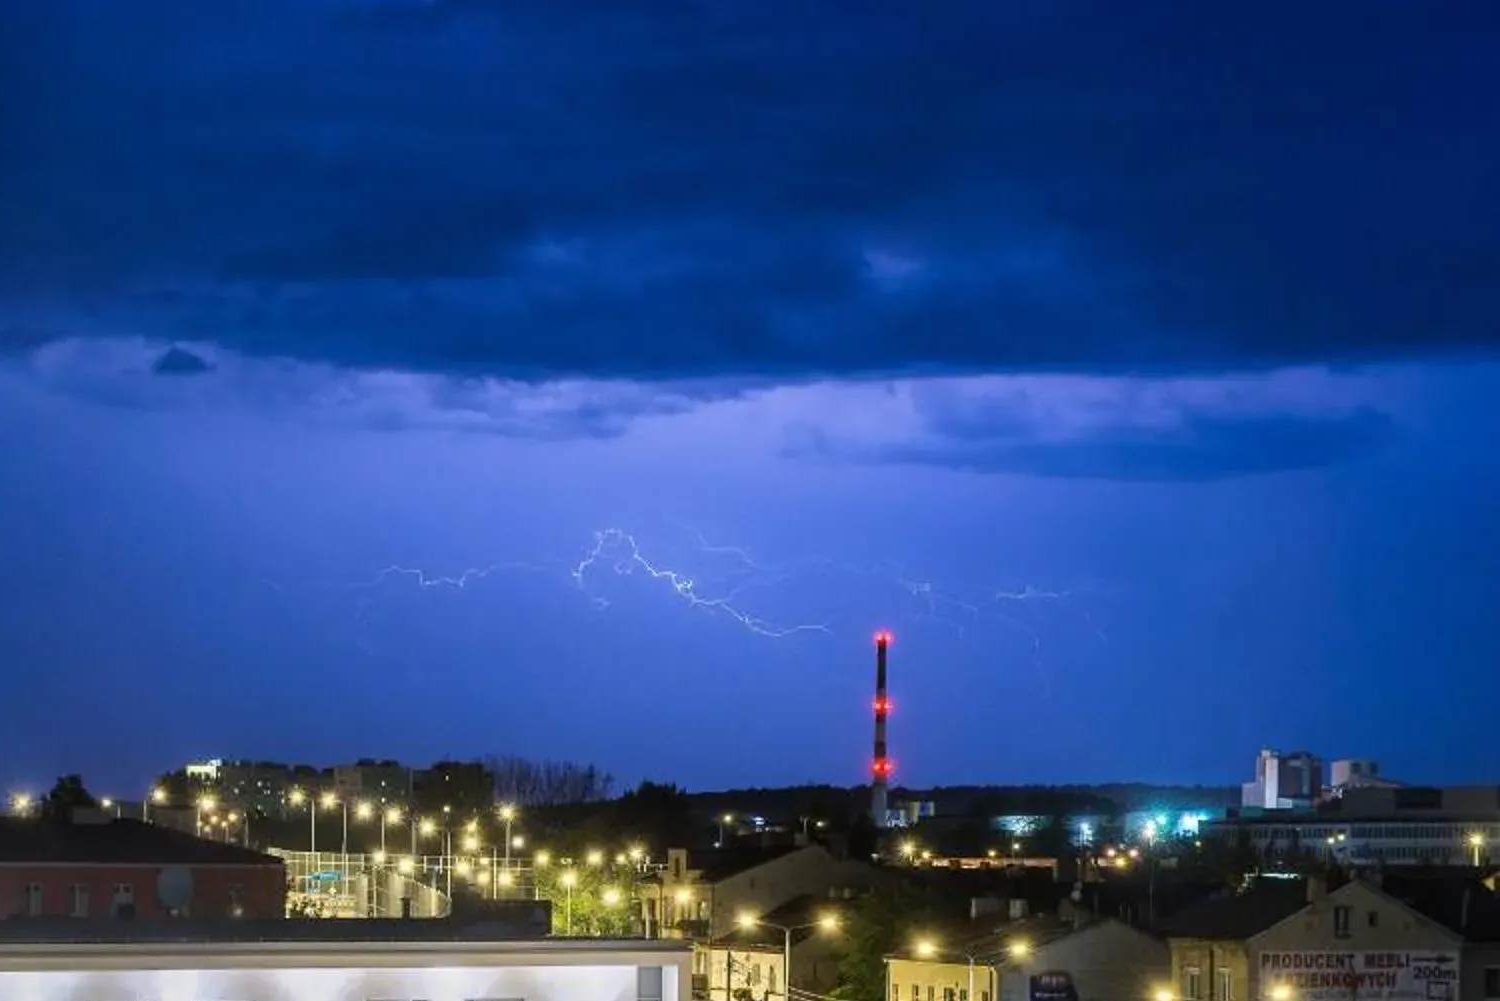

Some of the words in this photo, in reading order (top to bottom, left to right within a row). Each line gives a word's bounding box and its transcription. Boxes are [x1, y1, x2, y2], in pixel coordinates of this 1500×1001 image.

[1261, 954, 1355, 969] PRODUCENT
[1364, 953, 1411, 969] MEBLI
[1413, 967, 1457, 980] 200m
